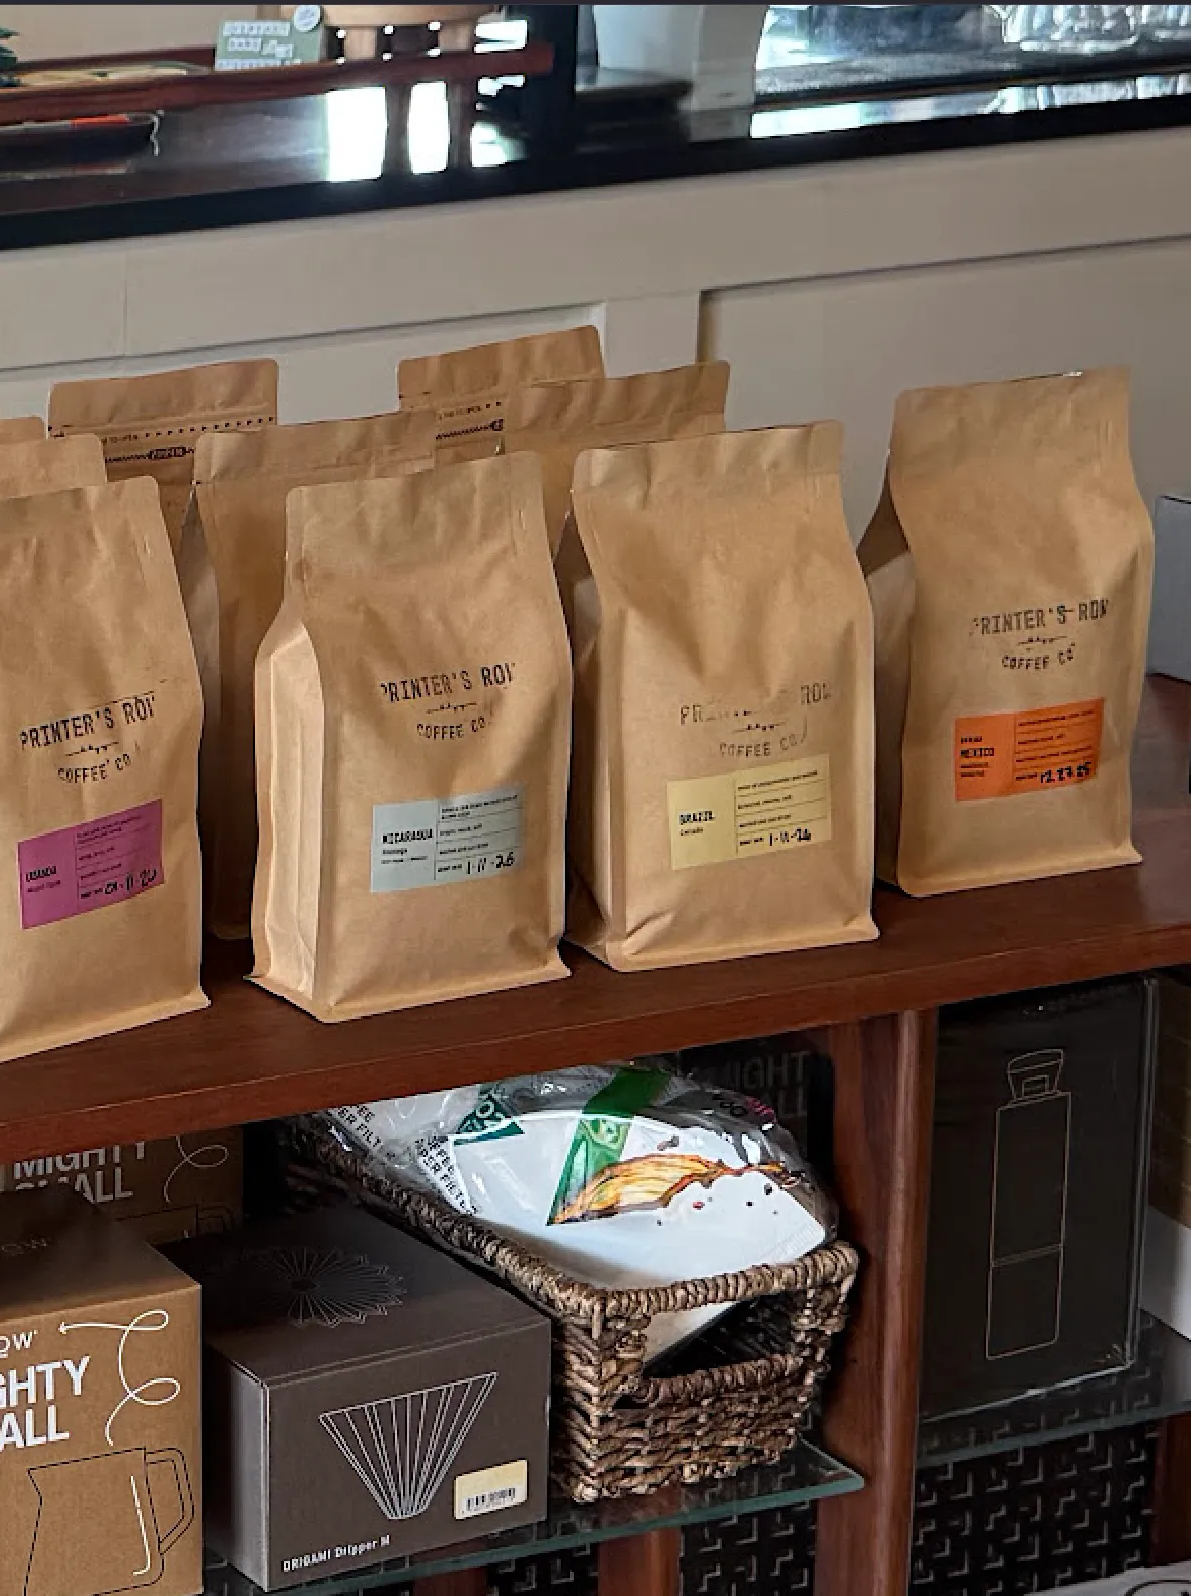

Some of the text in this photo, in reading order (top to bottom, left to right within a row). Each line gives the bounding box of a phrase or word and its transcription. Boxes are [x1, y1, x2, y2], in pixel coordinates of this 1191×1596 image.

[416, 723, 465, 740] COFFEE
[57, 759, 110, 784] COFFEE
[283, 1548, 331, 1572] ORIGAMI
[335, 1540, 378, 1558] Dripper
